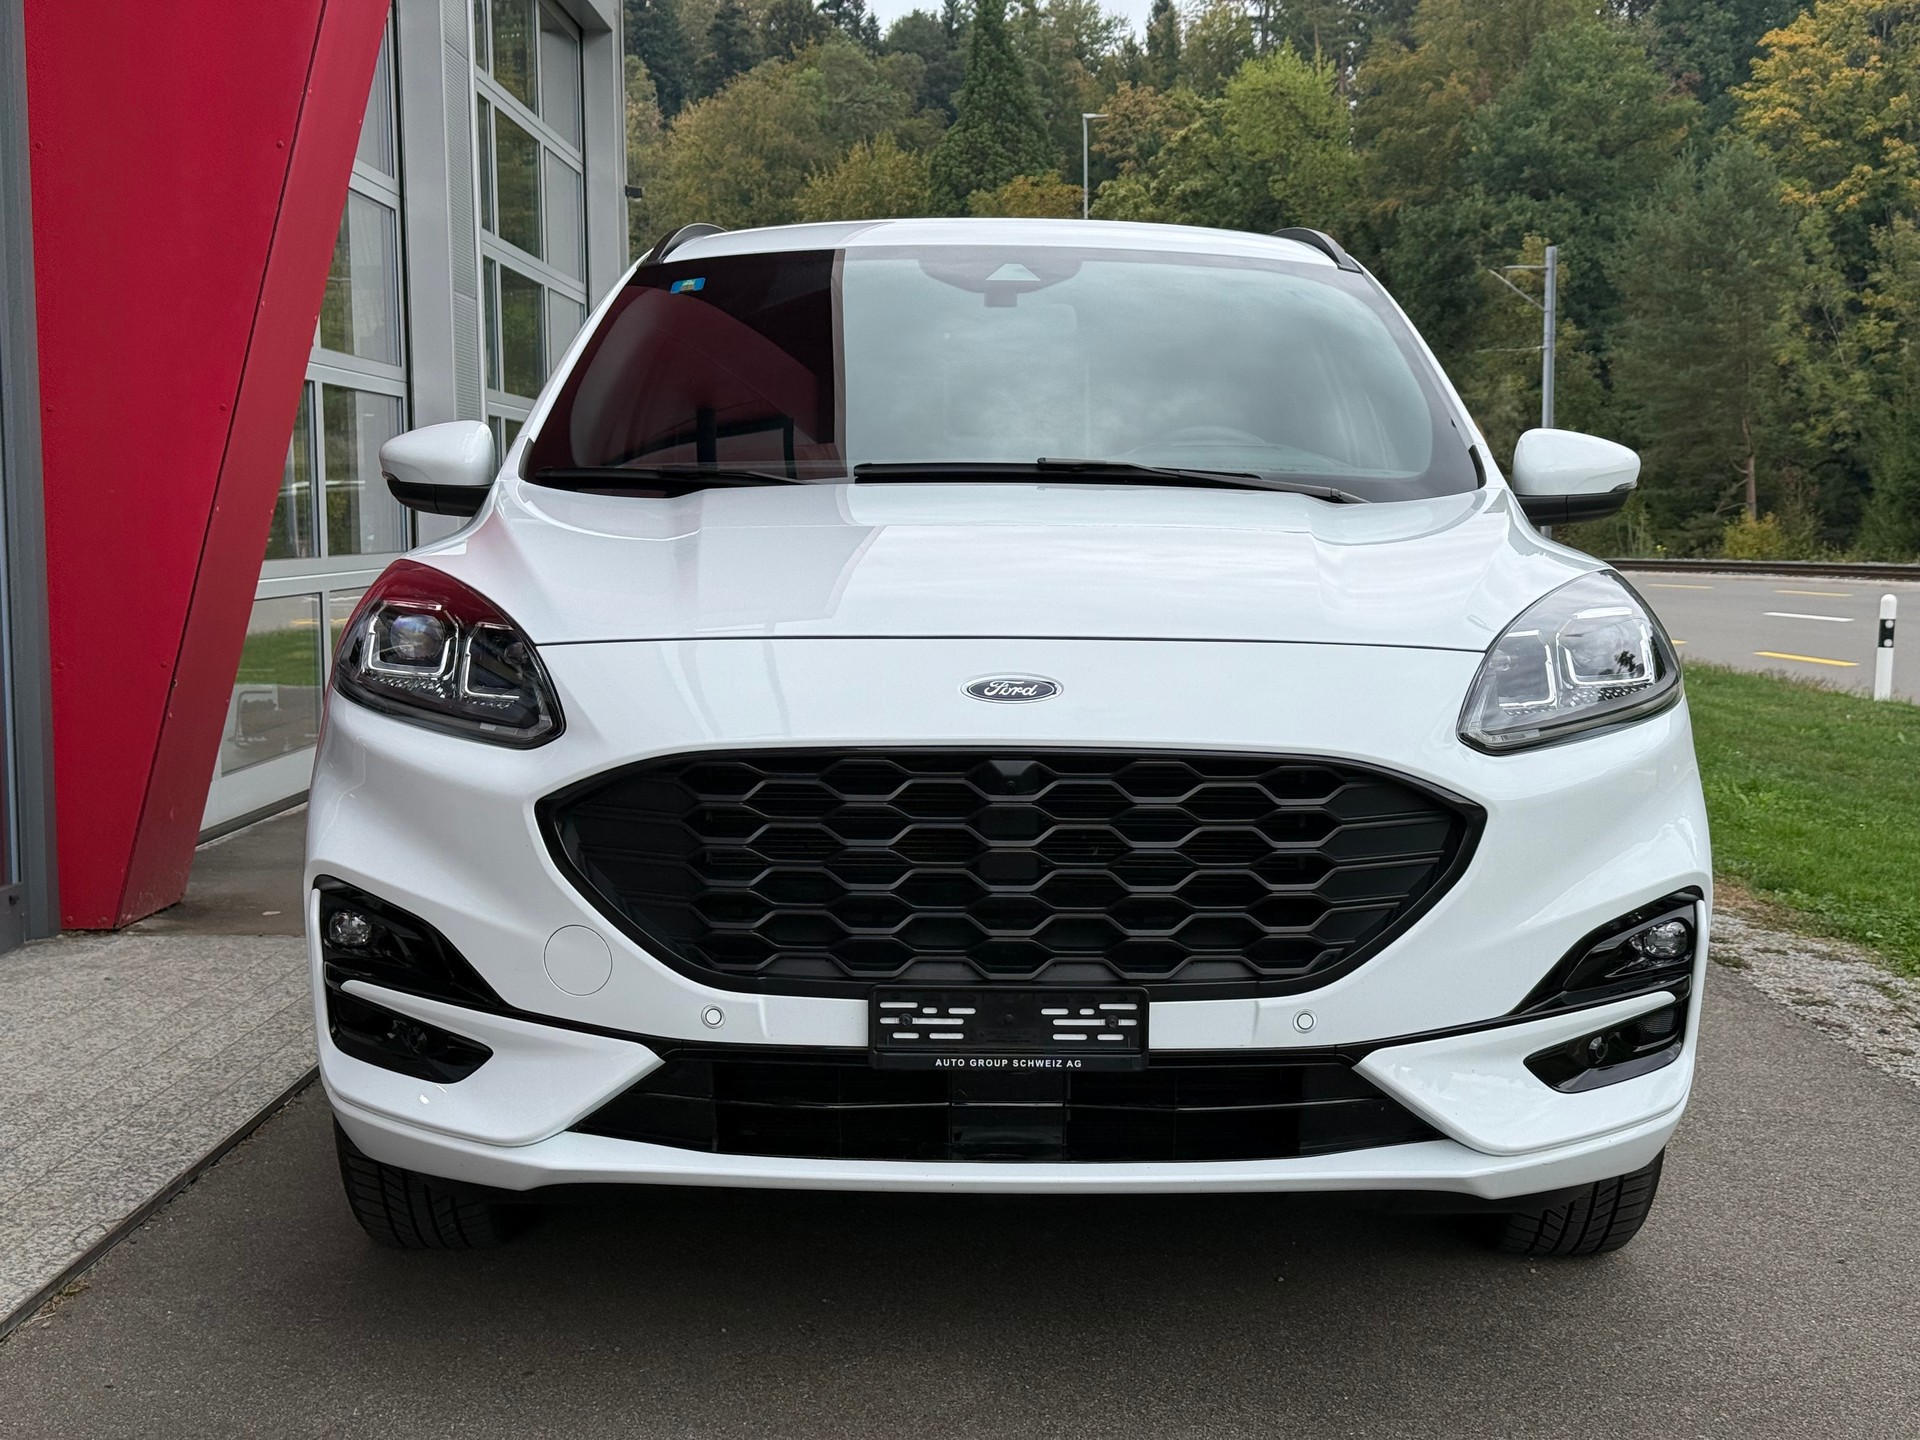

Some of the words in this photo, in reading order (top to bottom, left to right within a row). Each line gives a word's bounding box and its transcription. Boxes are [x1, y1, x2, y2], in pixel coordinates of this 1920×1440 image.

[984, 681, 1038, 696] Ford
[935, 1058, 965, 1068] AUTO
[969, 1058, 1008, 1068] GROUP
[1012, 1058, 1063, 1068] SCHWEIZ
[1066, 1058, 1082, 1068] AG
